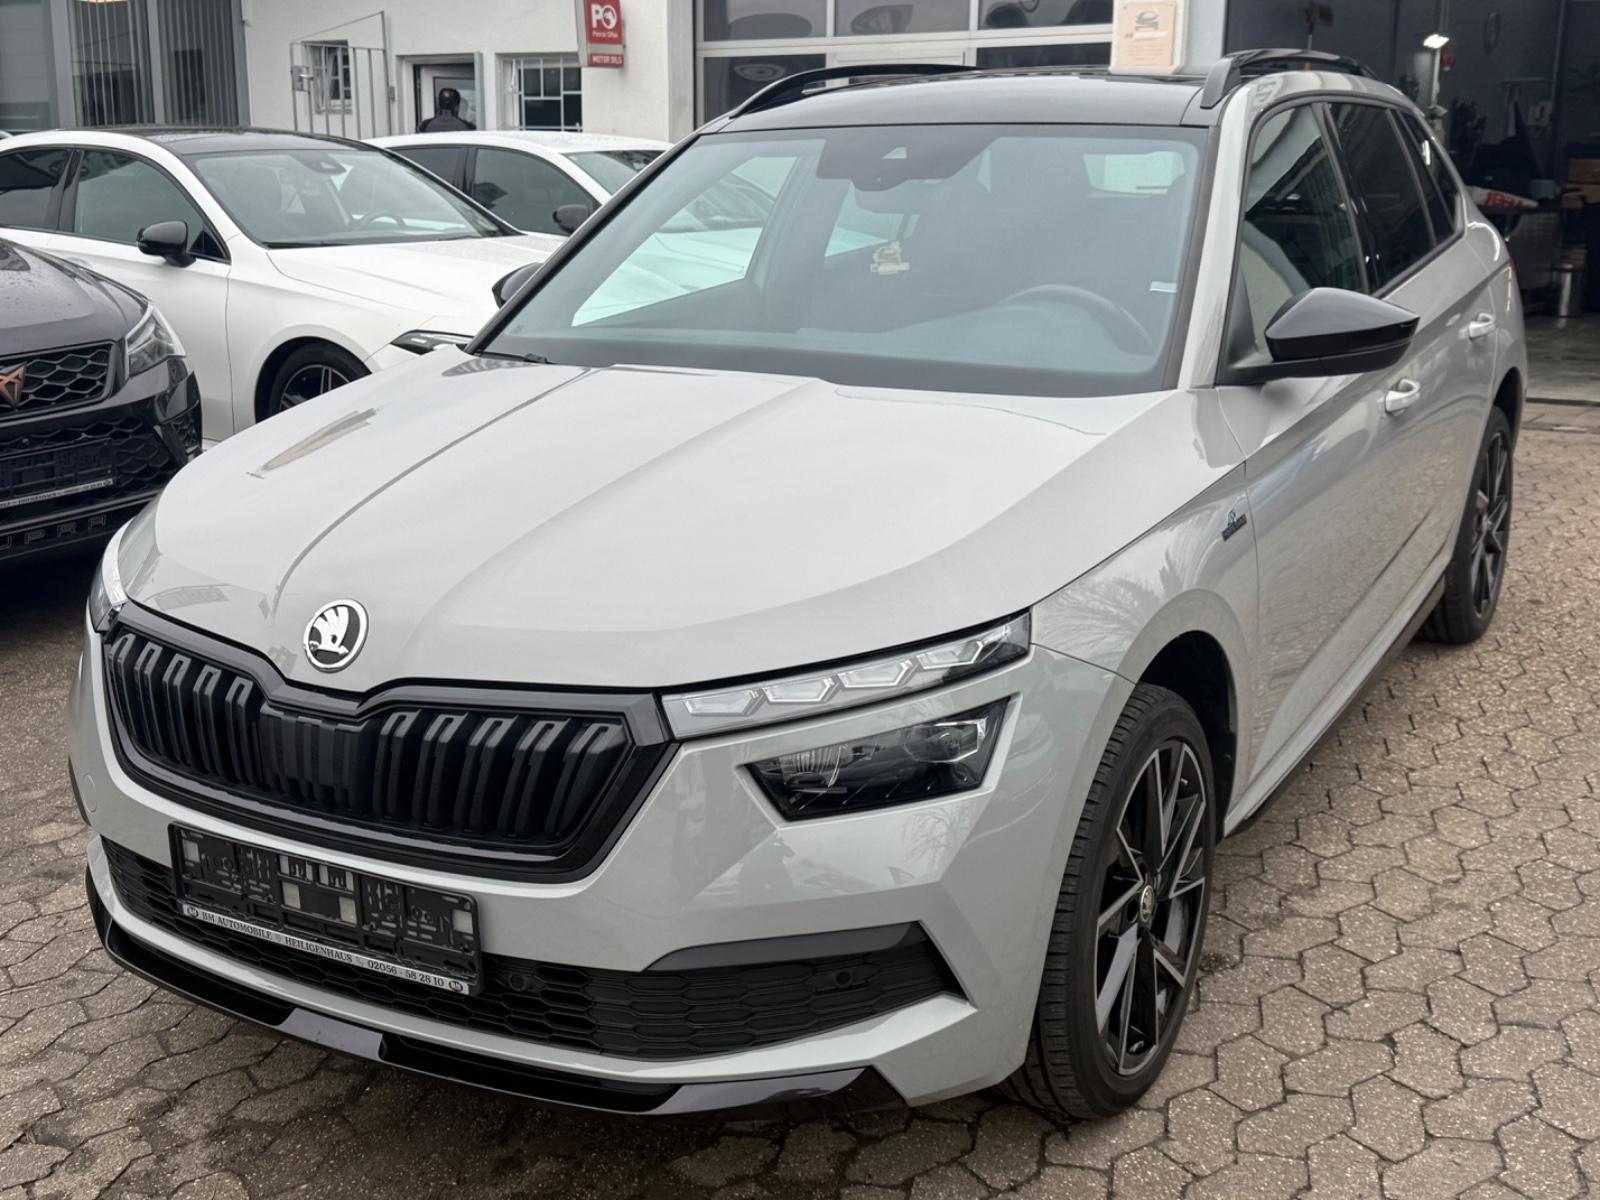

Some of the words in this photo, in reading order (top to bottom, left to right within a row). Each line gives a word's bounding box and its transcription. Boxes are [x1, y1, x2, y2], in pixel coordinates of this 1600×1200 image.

[592, 55, 610, 64] MOTOR
[611, 56, 623, 65] OILS
[202, 911, 215, 923] BM
[218, 916, 272, 940] AUTOMOBILE
[285, 936, 353, 963] HEILIGENHAUS
[367, 959, 398, 975] 02056
[405, 969, 417, 980] 58
[419, 973, 431, 984] 28
[433, 976, 445, 987] 10
